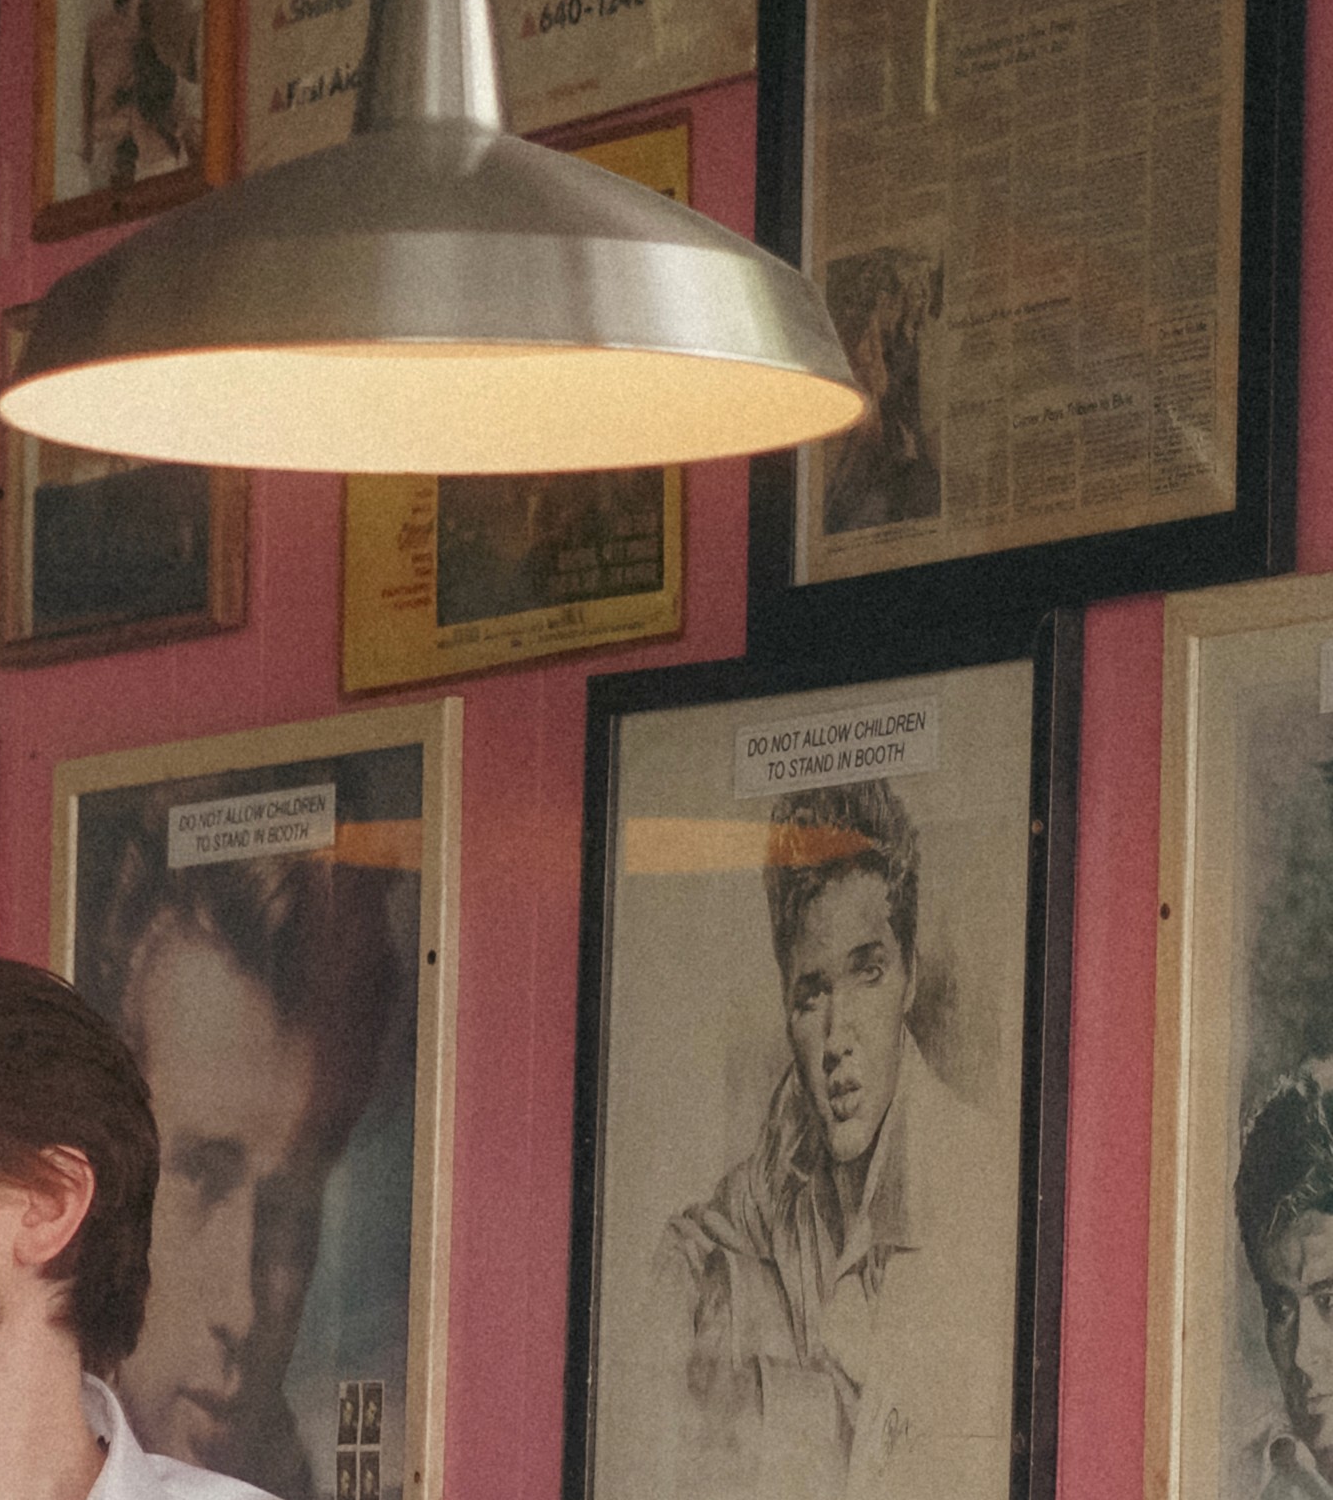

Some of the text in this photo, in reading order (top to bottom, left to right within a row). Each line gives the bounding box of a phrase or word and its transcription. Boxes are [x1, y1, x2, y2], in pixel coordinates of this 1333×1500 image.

[747, 711, 927, 758] DO NOT ALLOW CHILDREN
[768, 741, 906, 781] TO STAND IN BOOTH
[178, 794, 327, 832] DO NOT ALLOW CHILDREN
[195, 822, 310, 852] TO STAND IN BOOTH
